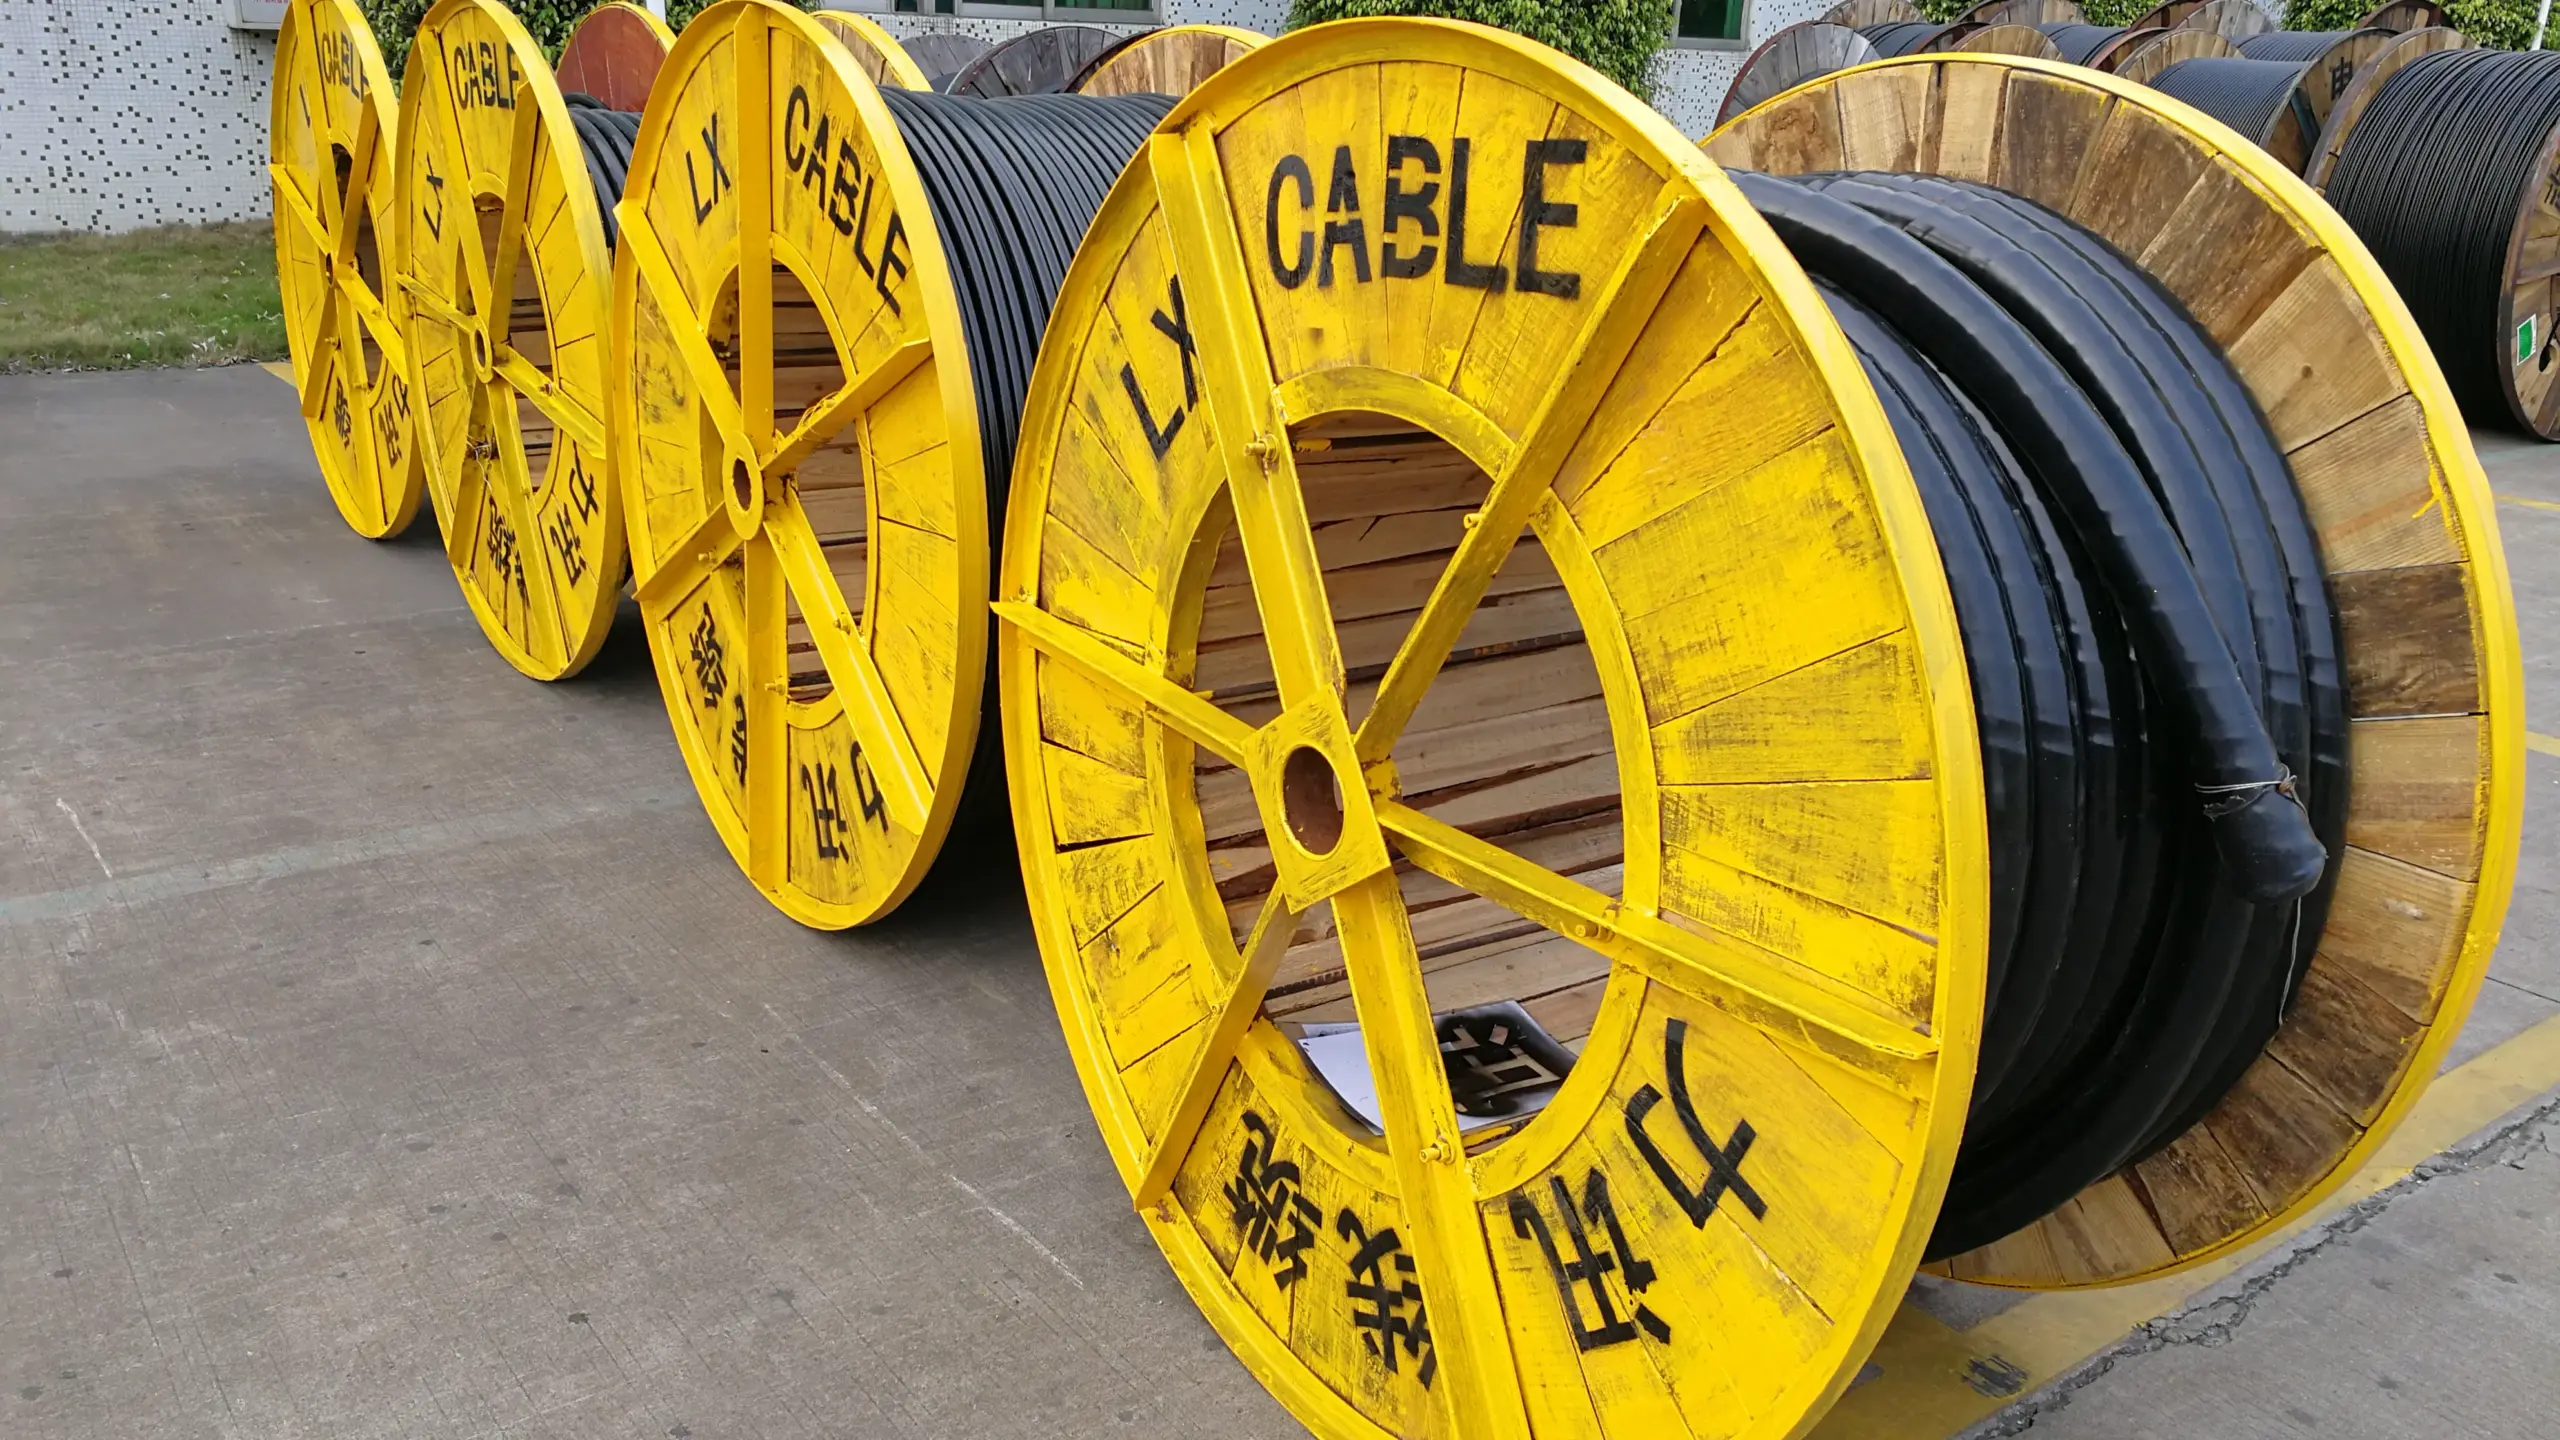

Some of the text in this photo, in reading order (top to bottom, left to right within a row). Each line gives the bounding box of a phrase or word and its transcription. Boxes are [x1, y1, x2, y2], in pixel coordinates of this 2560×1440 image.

[684, 84, 911, 318] LX CABLE
[1119, 133, 1588, 461] LX CABLE
